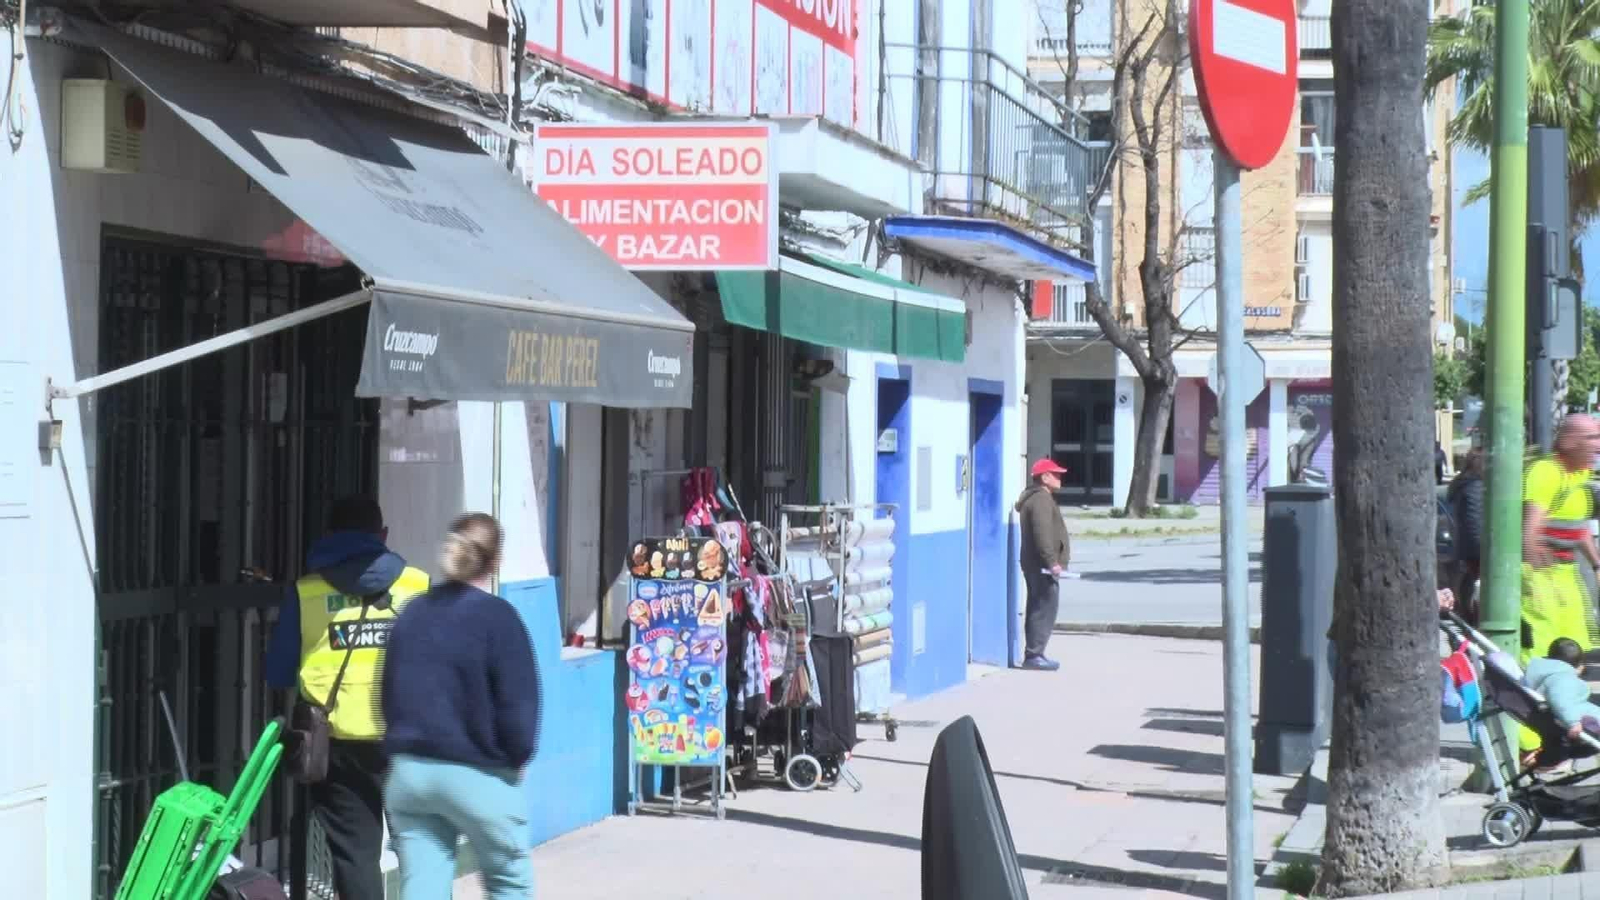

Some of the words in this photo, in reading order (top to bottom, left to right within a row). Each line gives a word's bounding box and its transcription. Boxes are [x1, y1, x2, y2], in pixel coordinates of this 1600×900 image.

[545, 144, 596, 176] DÍA
[612, 147, 762, 176] SOLEADO
[617, 234, 720, 260] BAZAR
[384, 322, 440, 360] Cruzcampo
[540, 332, 562, 387] BAR
